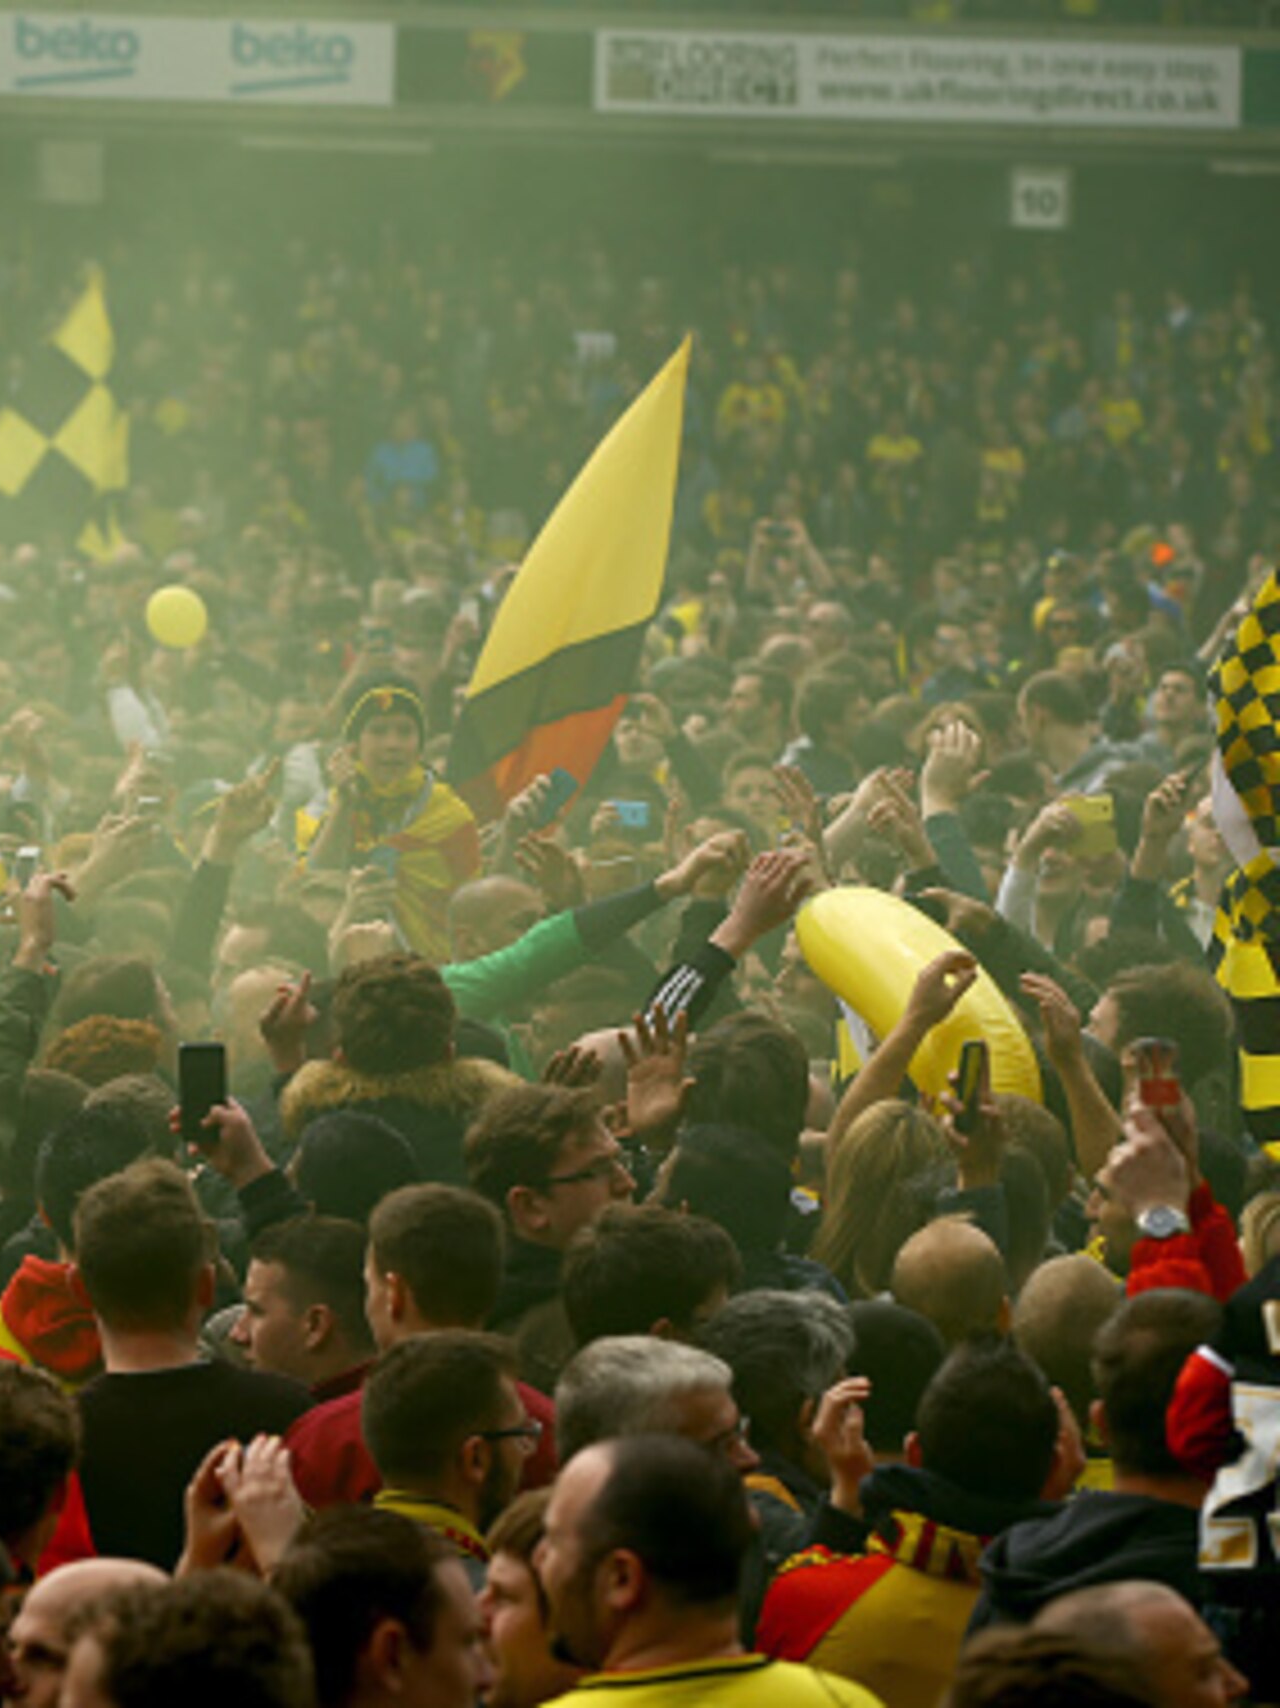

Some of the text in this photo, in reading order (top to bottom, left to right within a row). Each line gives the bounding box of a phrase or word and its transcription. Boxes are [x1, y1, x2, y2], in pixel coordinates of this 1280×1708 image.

[15, 17, 138, 59] beko
[231, 23, 355, 66] beko
[1021, 186, 1059, 217] 10
